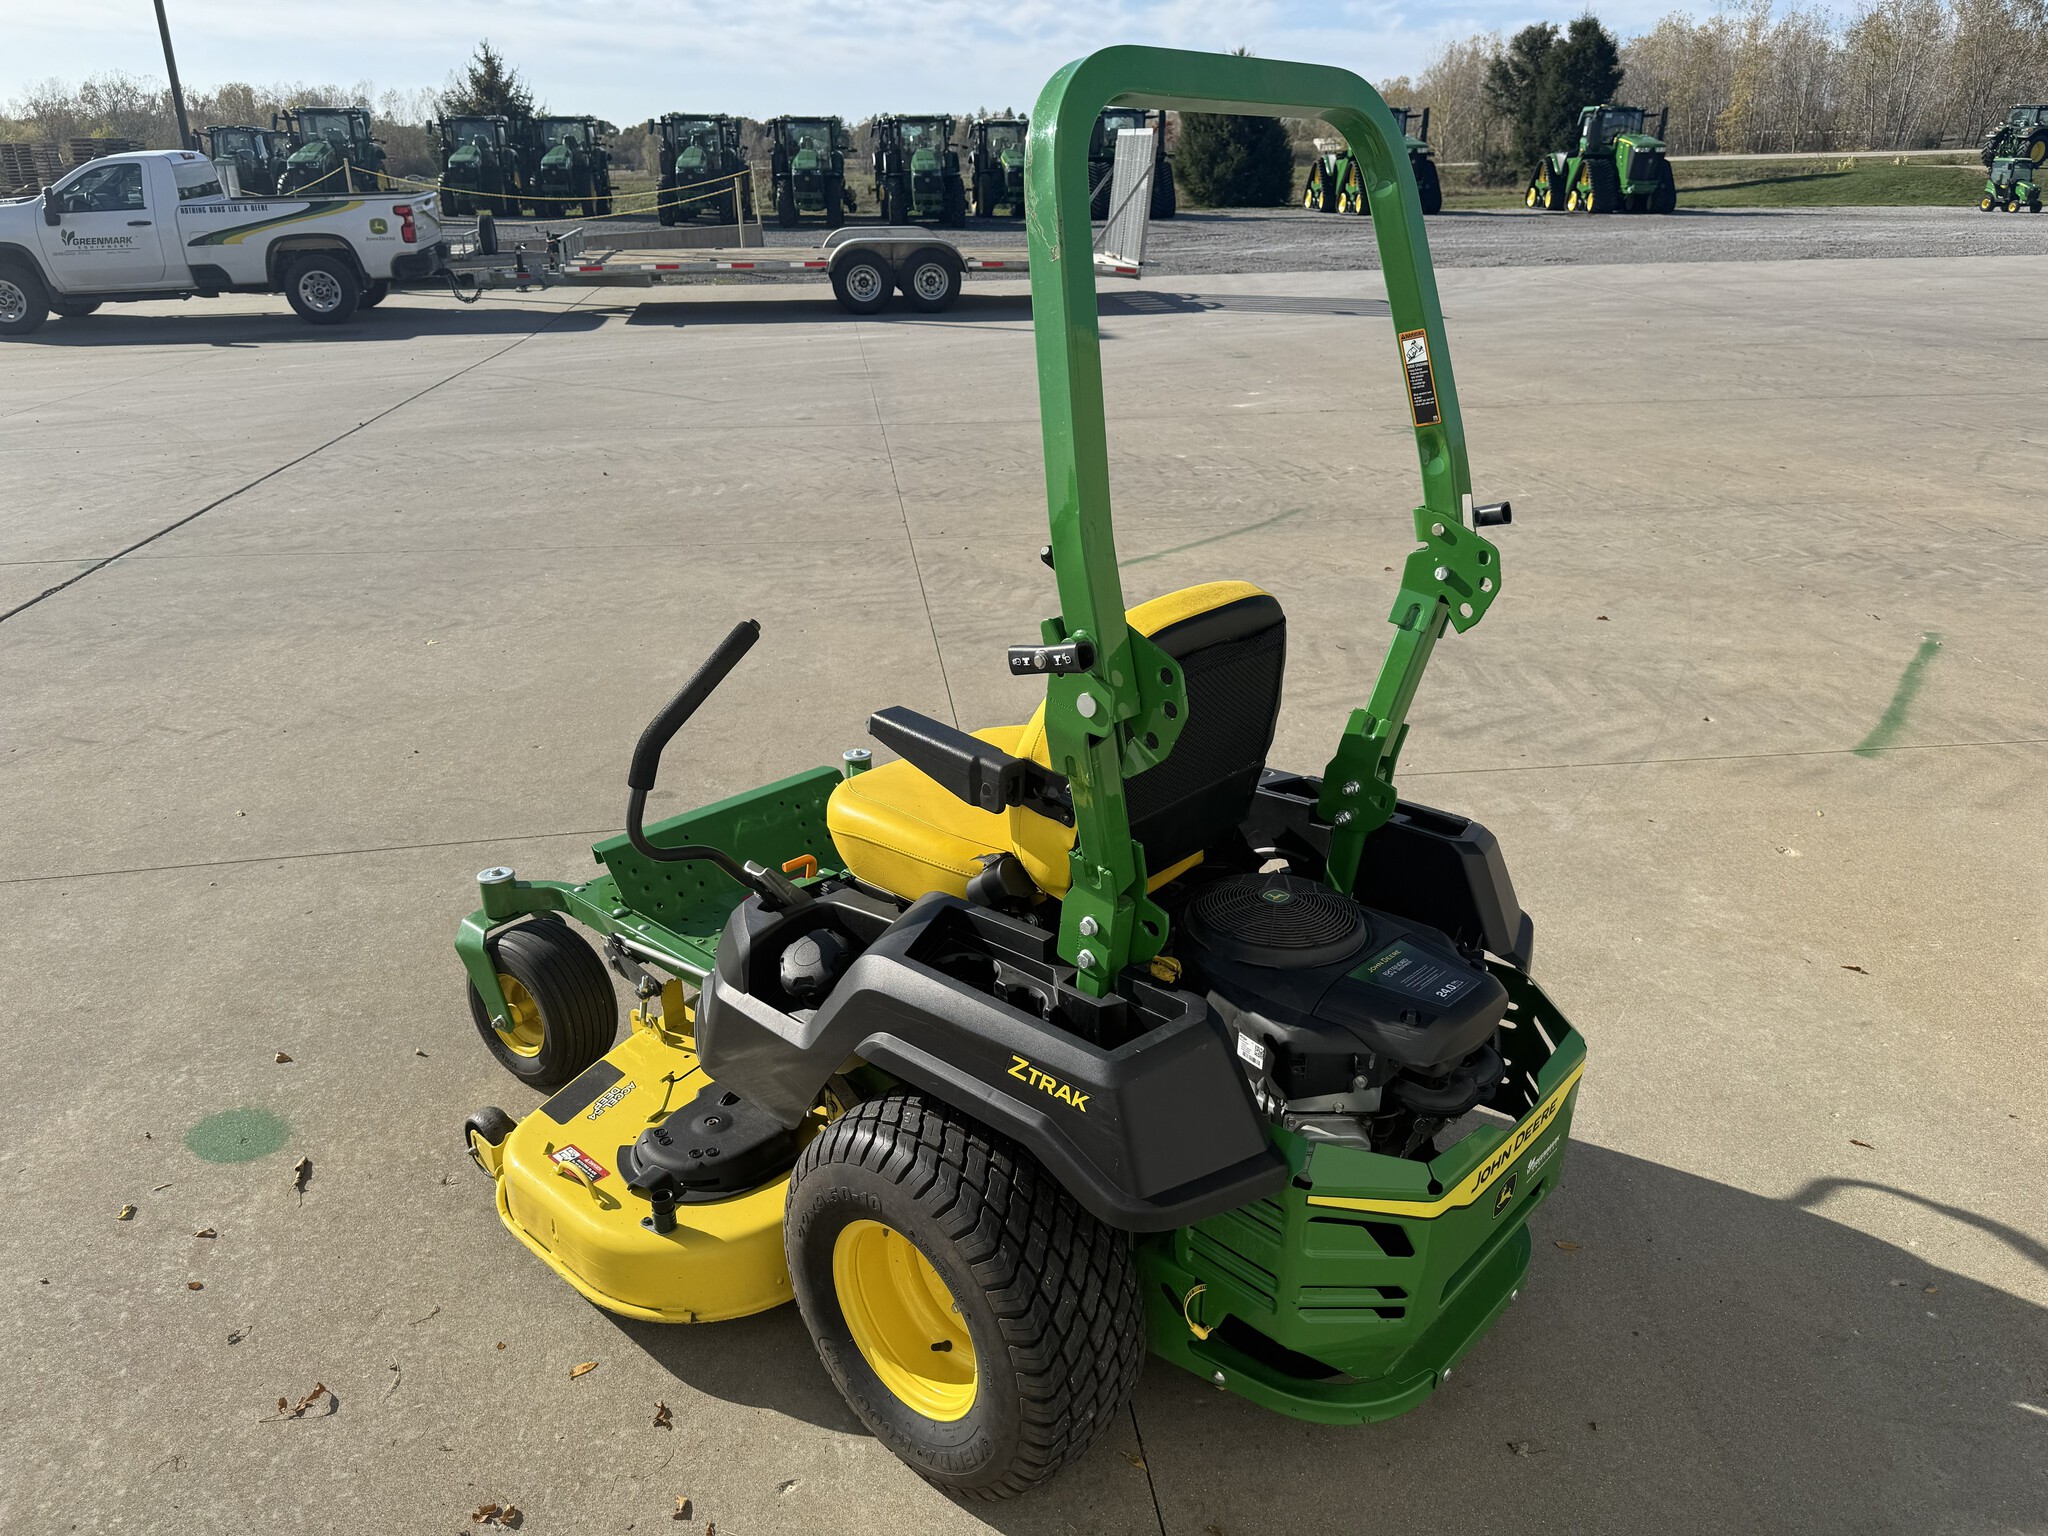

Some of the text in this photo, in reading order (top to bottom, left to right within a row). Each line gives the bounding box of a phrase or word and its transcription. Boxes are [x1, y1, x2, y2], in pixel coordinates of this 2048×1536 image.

[180, 206, 206, 215] NOTHING
[72, 236, 132, 246] GREENMARK
[1435, 983, 1457, 998] 24.0
[1007, 1055, 1090, 1113] ZTRAK
[1471, 1144, 1512, 1194] JOHN
[1514, 1097, 1558, 1153] DEERE
